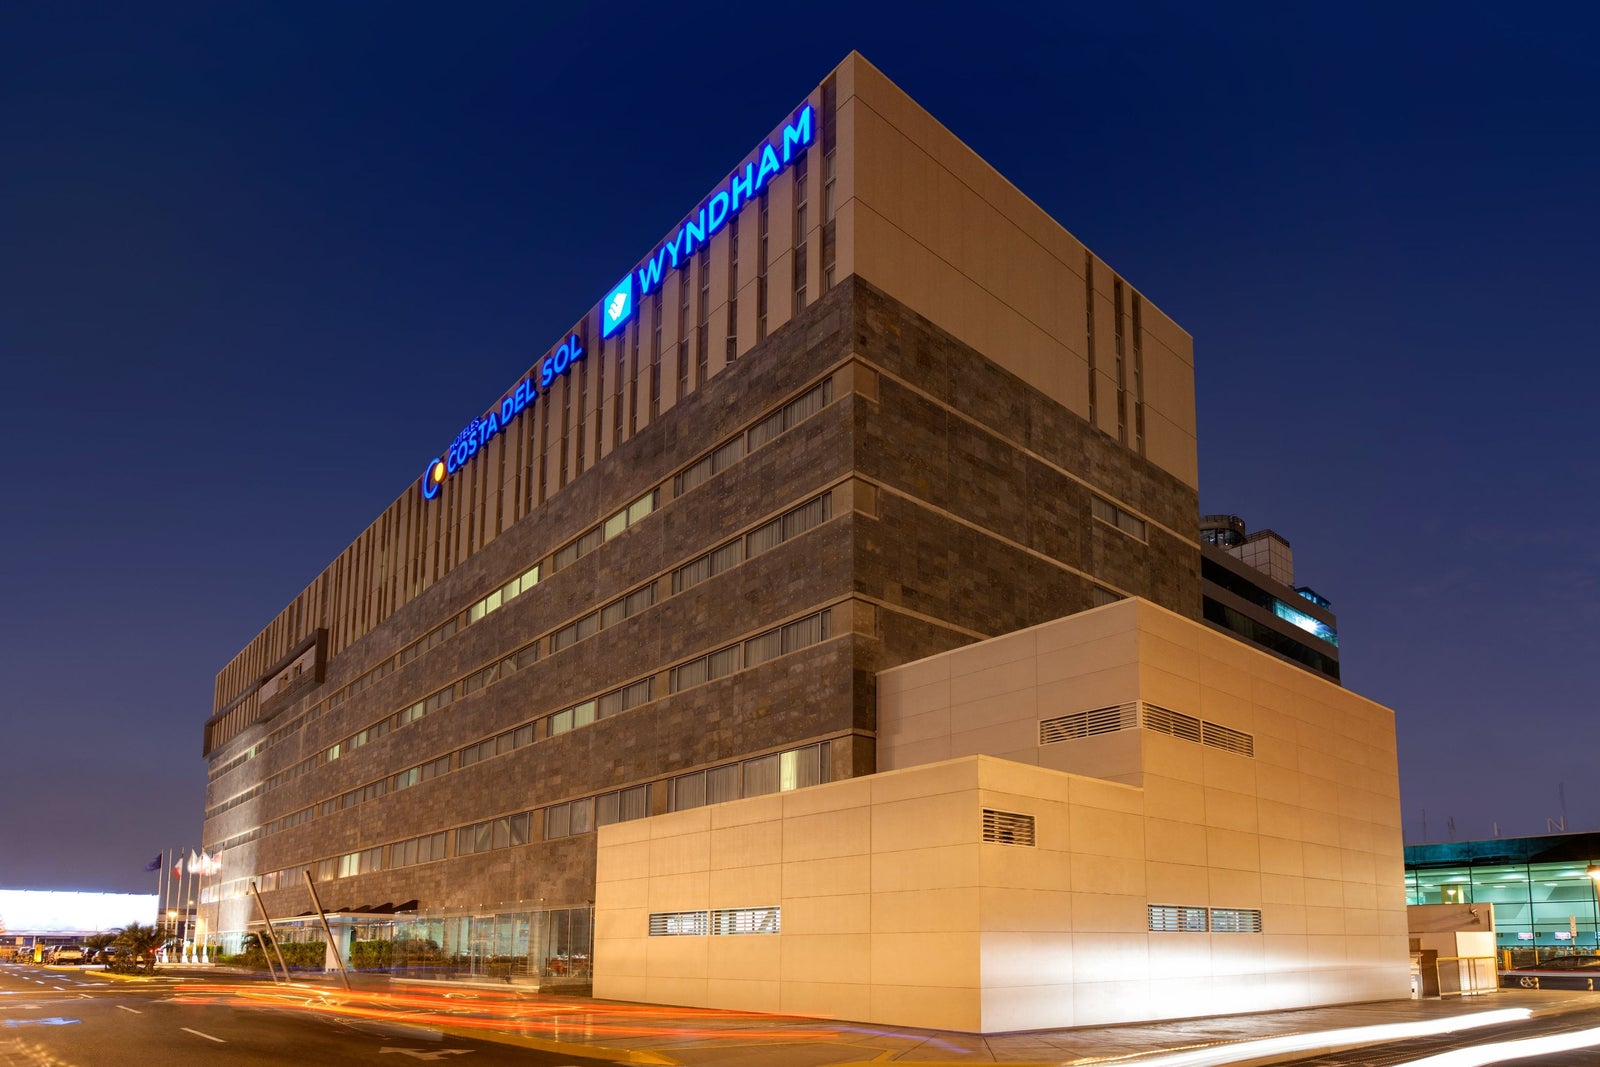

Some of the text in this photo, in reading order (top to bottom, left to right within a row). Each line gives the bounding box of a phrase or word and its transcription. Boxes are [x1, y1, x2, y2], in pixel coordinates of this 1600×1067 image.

[638, 104, 813, 294] WYNDHAM
[447, 334, 582, 474] COSTA DEL SOL
